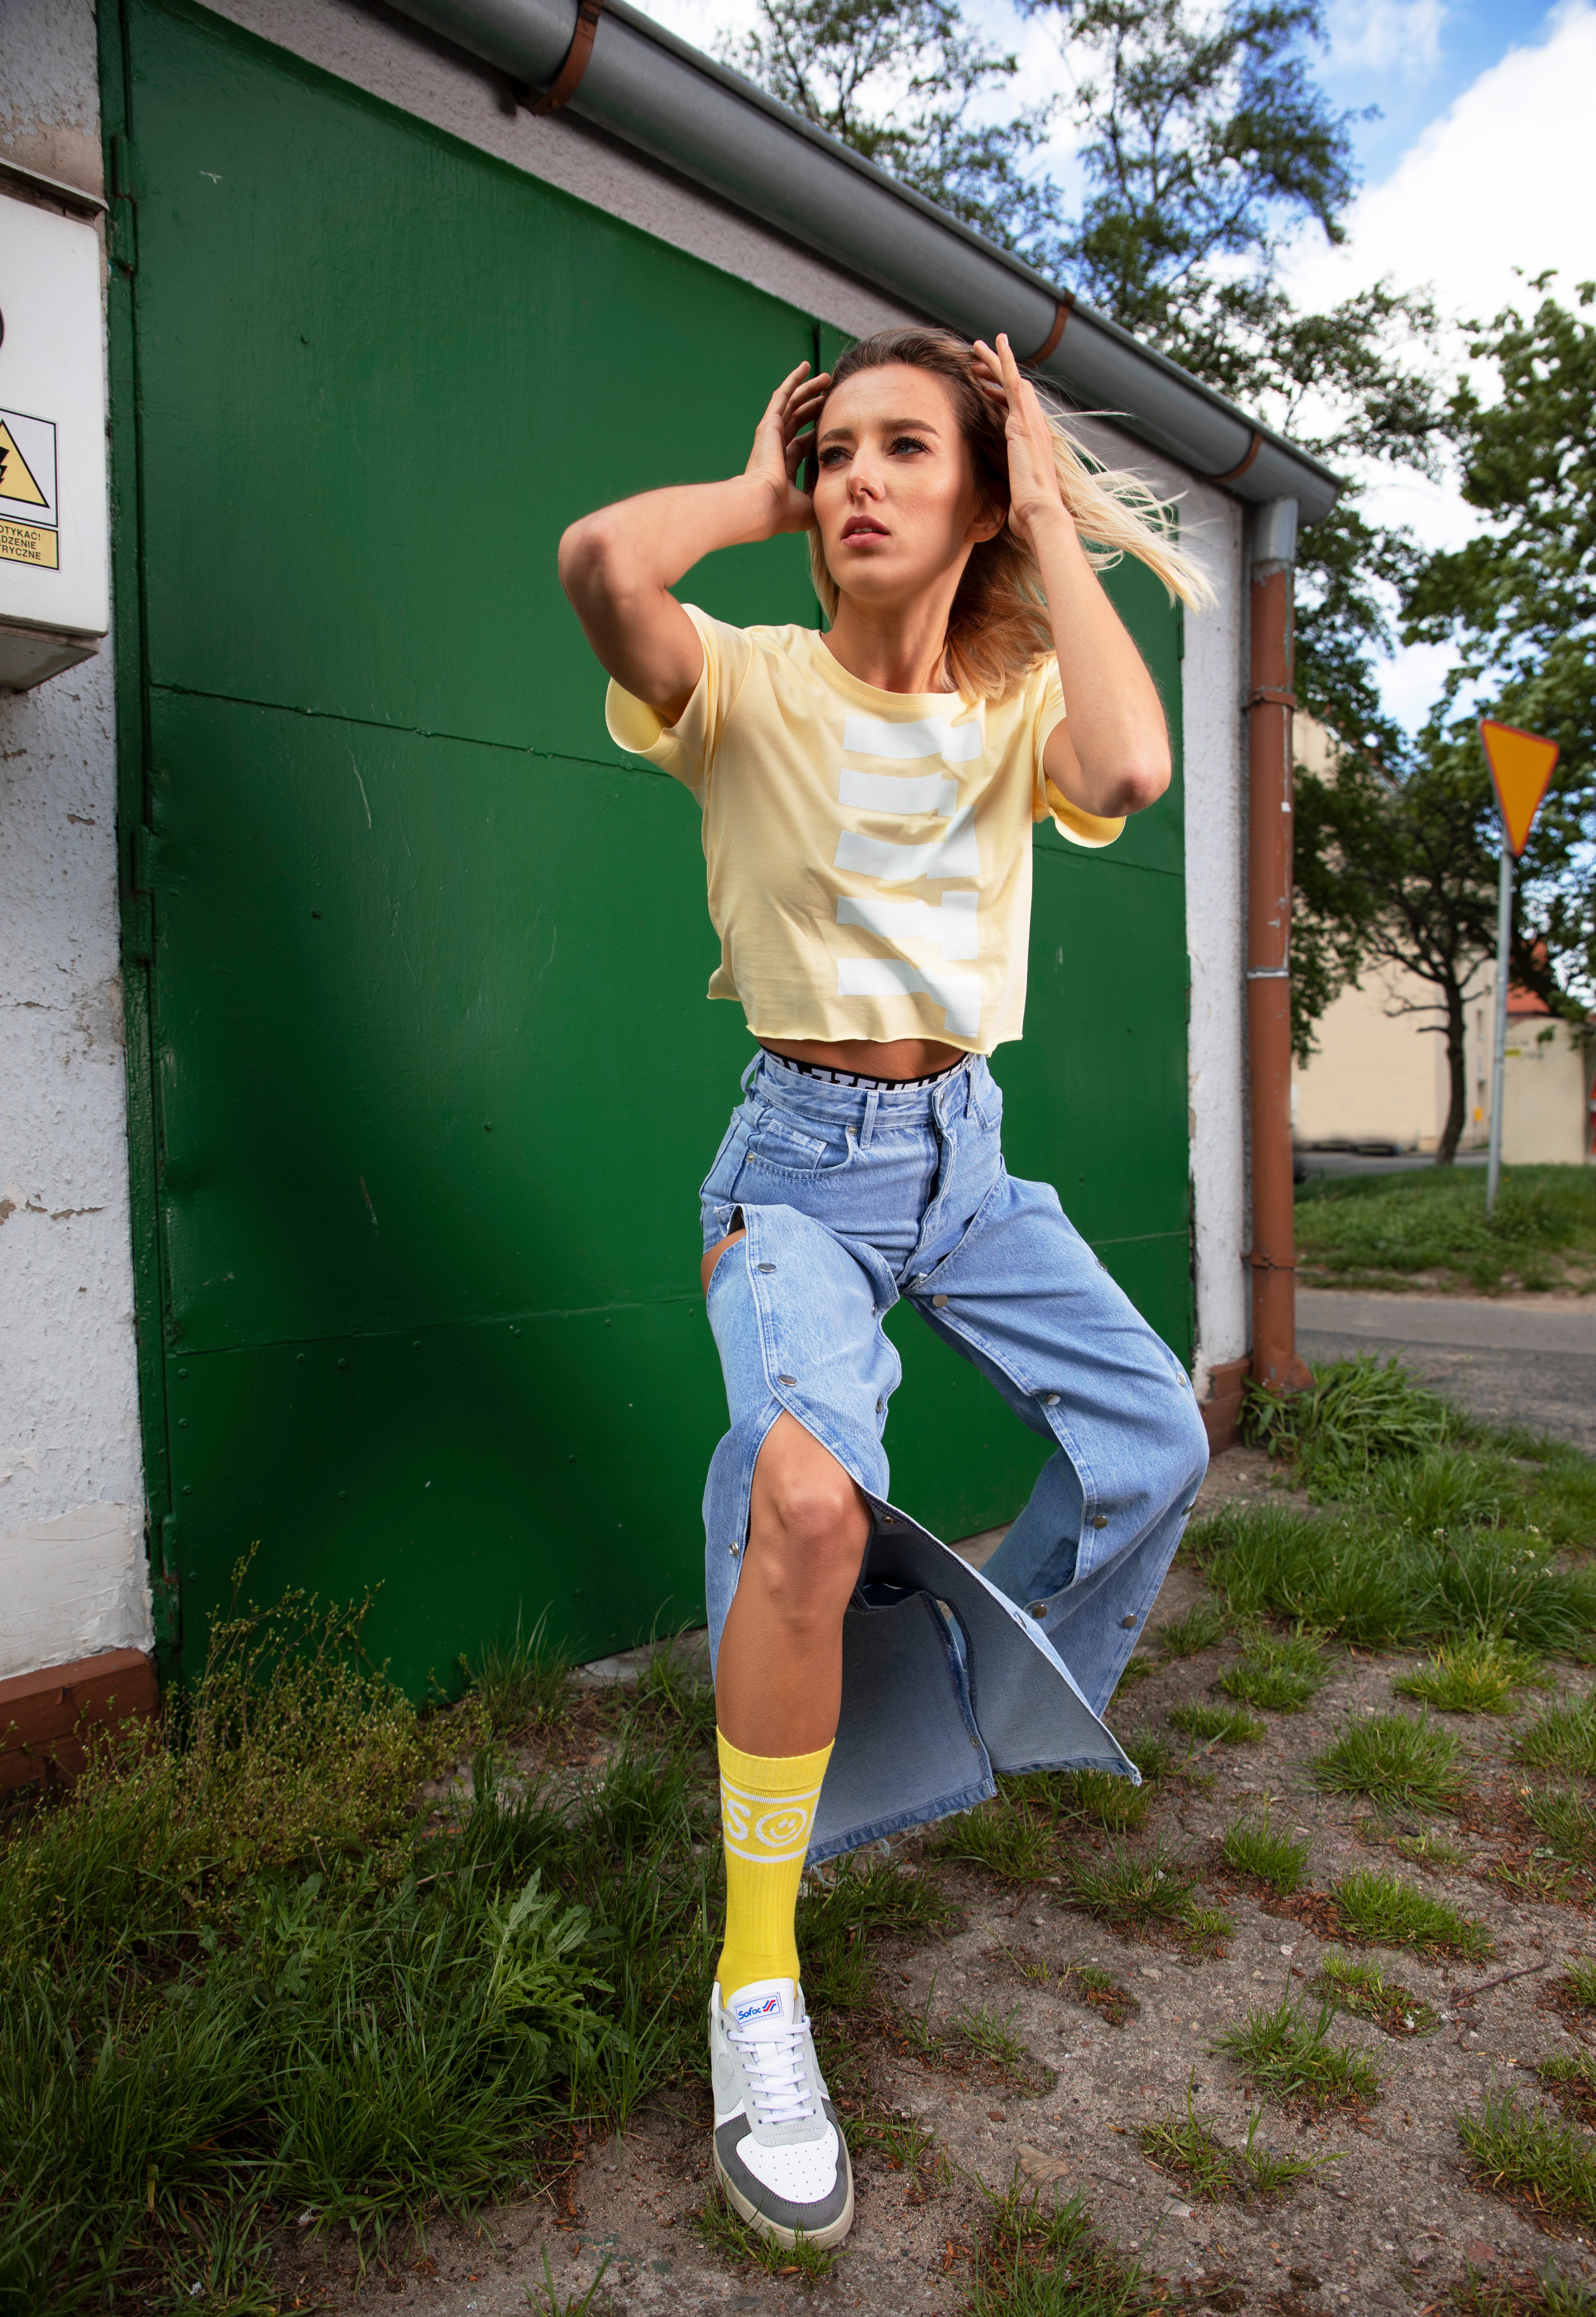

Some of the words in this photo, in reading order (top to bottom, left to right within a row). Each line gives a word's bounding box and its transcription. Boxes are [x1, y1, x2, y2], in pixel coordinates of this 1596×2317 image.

[0, 535, 36, 549] DZENIE
[0, 544, 41, 560] RYCZNE
[738, 2007, 761, 2020] Sofix
